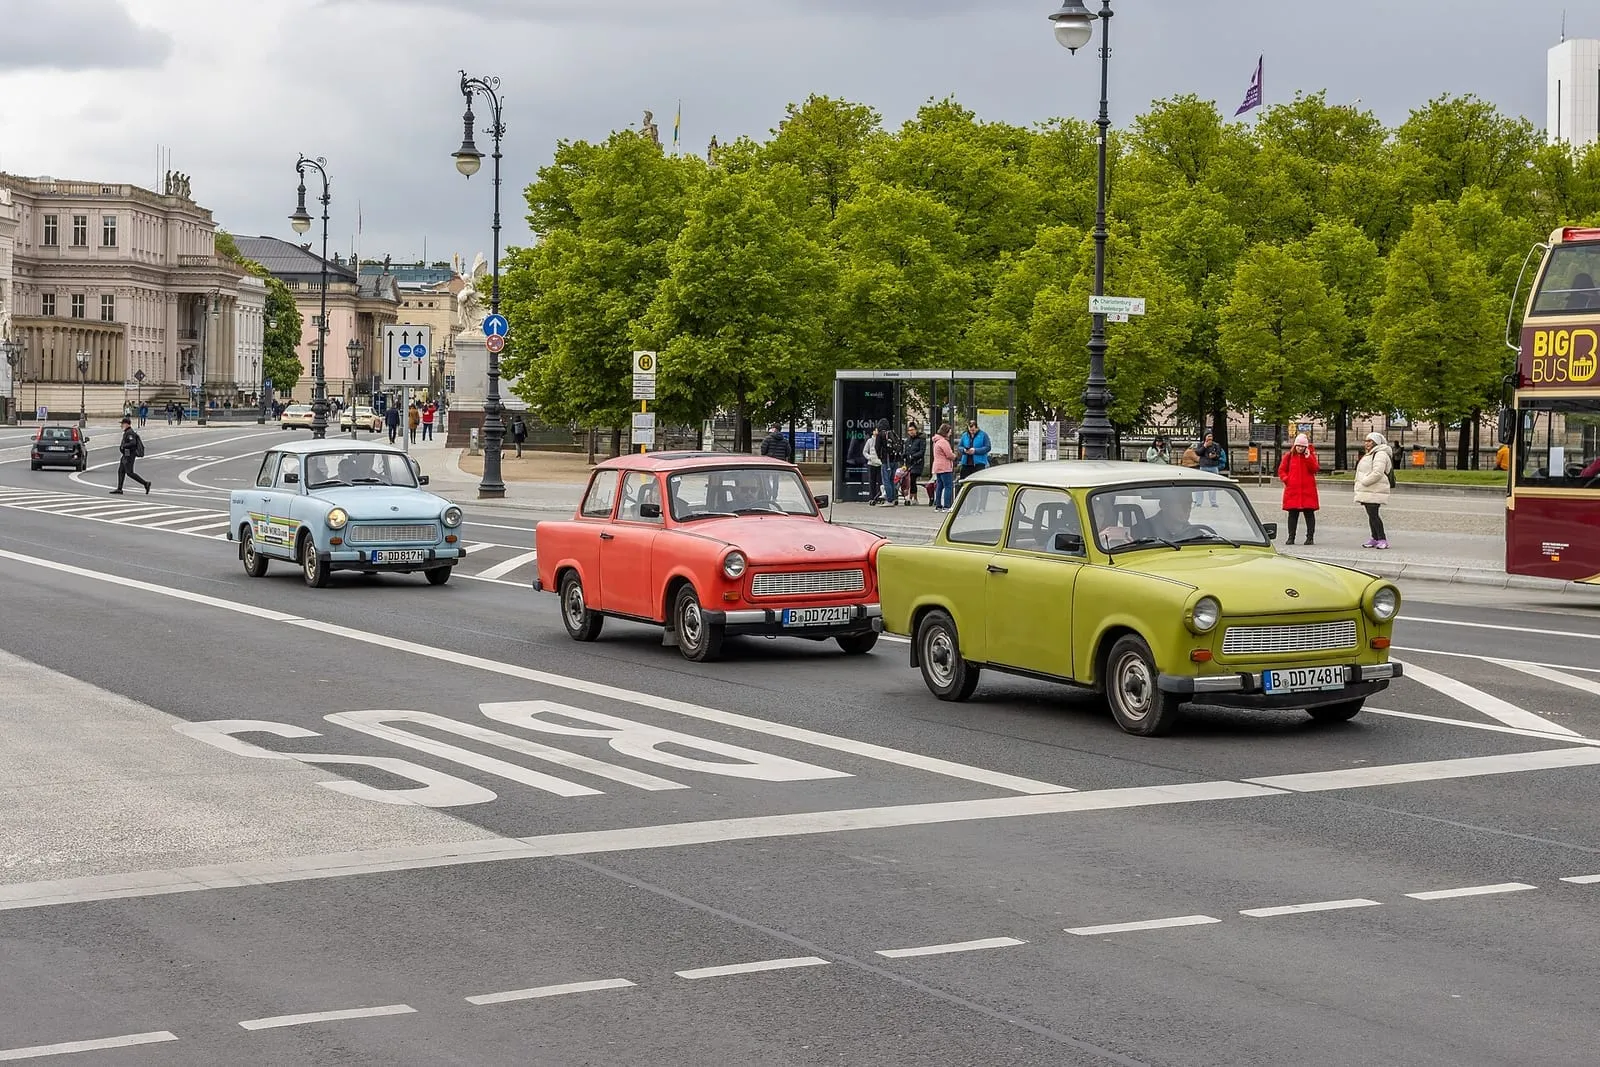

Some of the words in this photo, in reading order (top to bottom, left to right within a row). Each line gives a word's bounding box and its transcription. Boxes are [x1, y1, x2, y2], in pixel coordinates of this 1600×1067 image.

[1533, 330, 1569, 357] BIG
[1532, 358, 1567, 382] BUS
[846, 420, 854, 428] O
[377, 551, 383, 560] B
[790, 611, 797, 622] B
[1272, 673, 1281, 688] B
[171, 700, 857, 807] BUS
